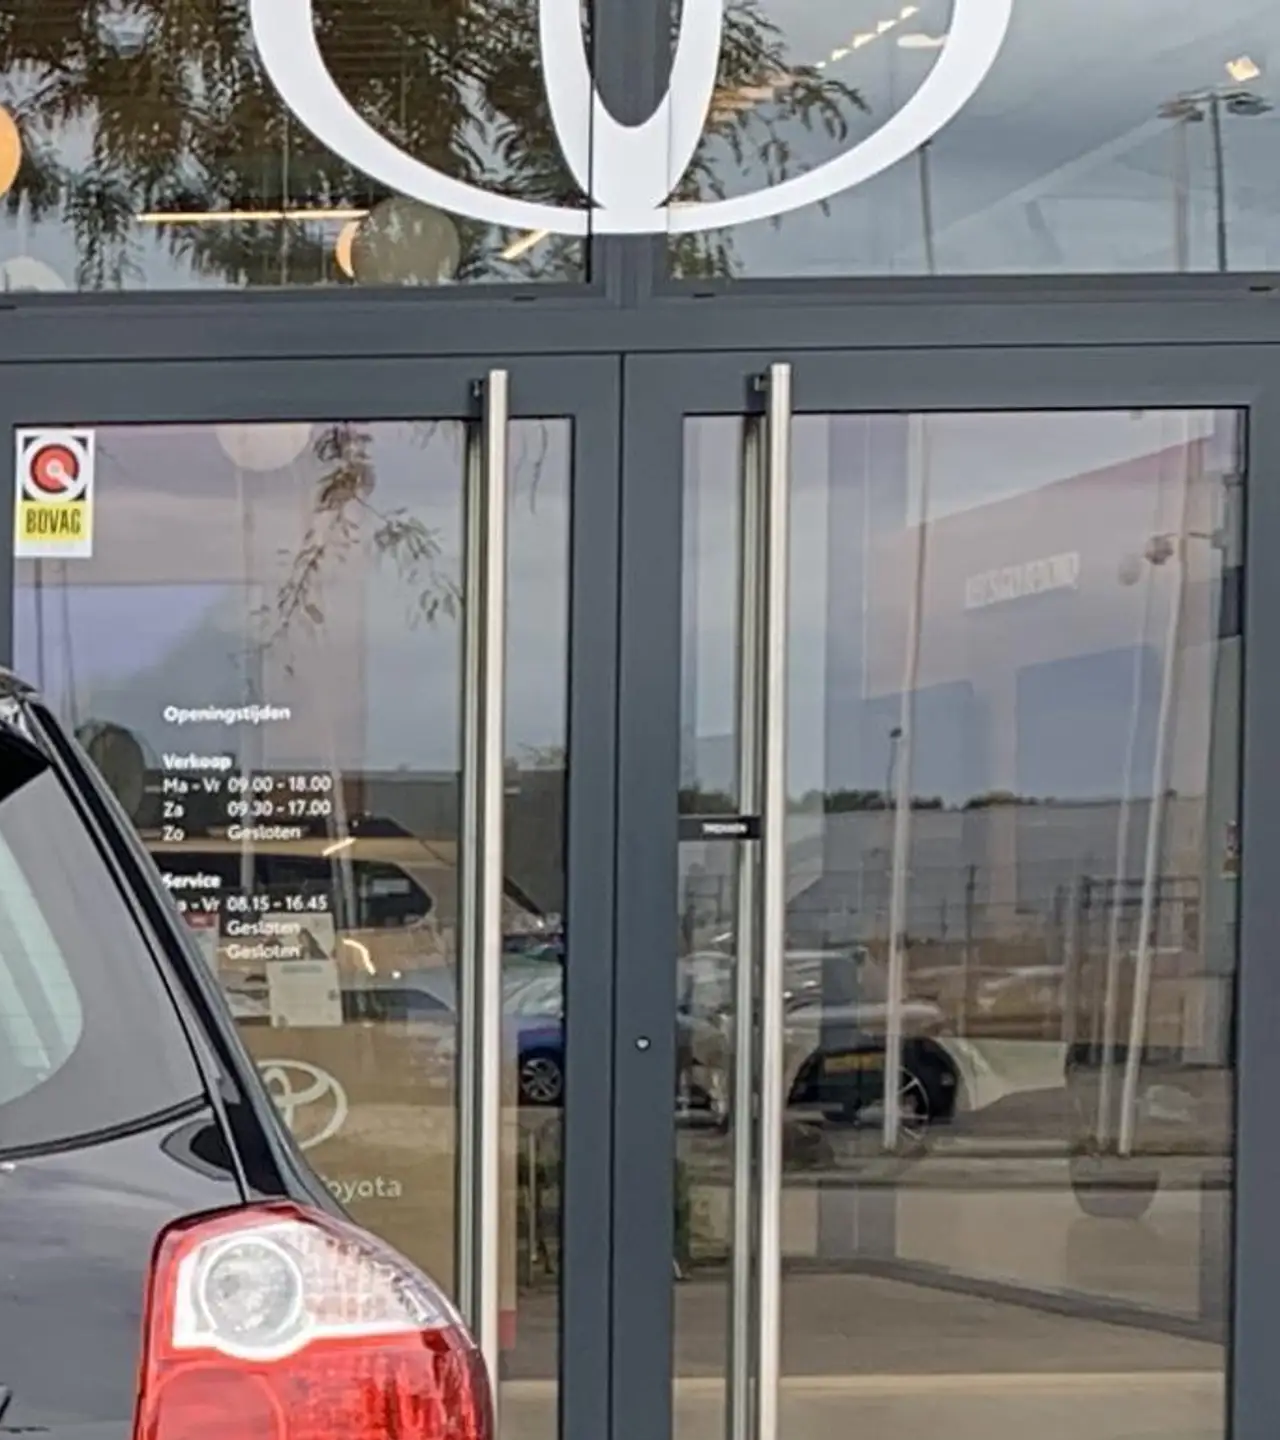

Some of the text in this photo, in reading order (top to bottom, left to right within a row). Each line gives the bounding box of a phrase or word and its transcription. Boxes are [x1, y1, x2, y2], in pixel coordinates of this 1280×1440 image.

[25, 508, 81, 535] BOVAG
[163, 706, 291, 725] Openingstijden
[162, 754, 232, 771] Verkoop
[163, 778, 189, 793] Ma
[202, 779, 221, 793] Vr
[227, 776, 273, 792] 09.00
[288, 776, 332, 792] 18.00
[163, 803, 184, 818] Za
[288, 800, 332, 816] 17.00
[163, 825, 301, 842] Zo Gesloten
[162, 873, 221, 889] Service
[202, 898, 221, 912] Vr
[226, 920, 301, 937] Gesloten
[226, 944, 301, 960] Gesloten
[321, 1175, 403, 1203] oyota
